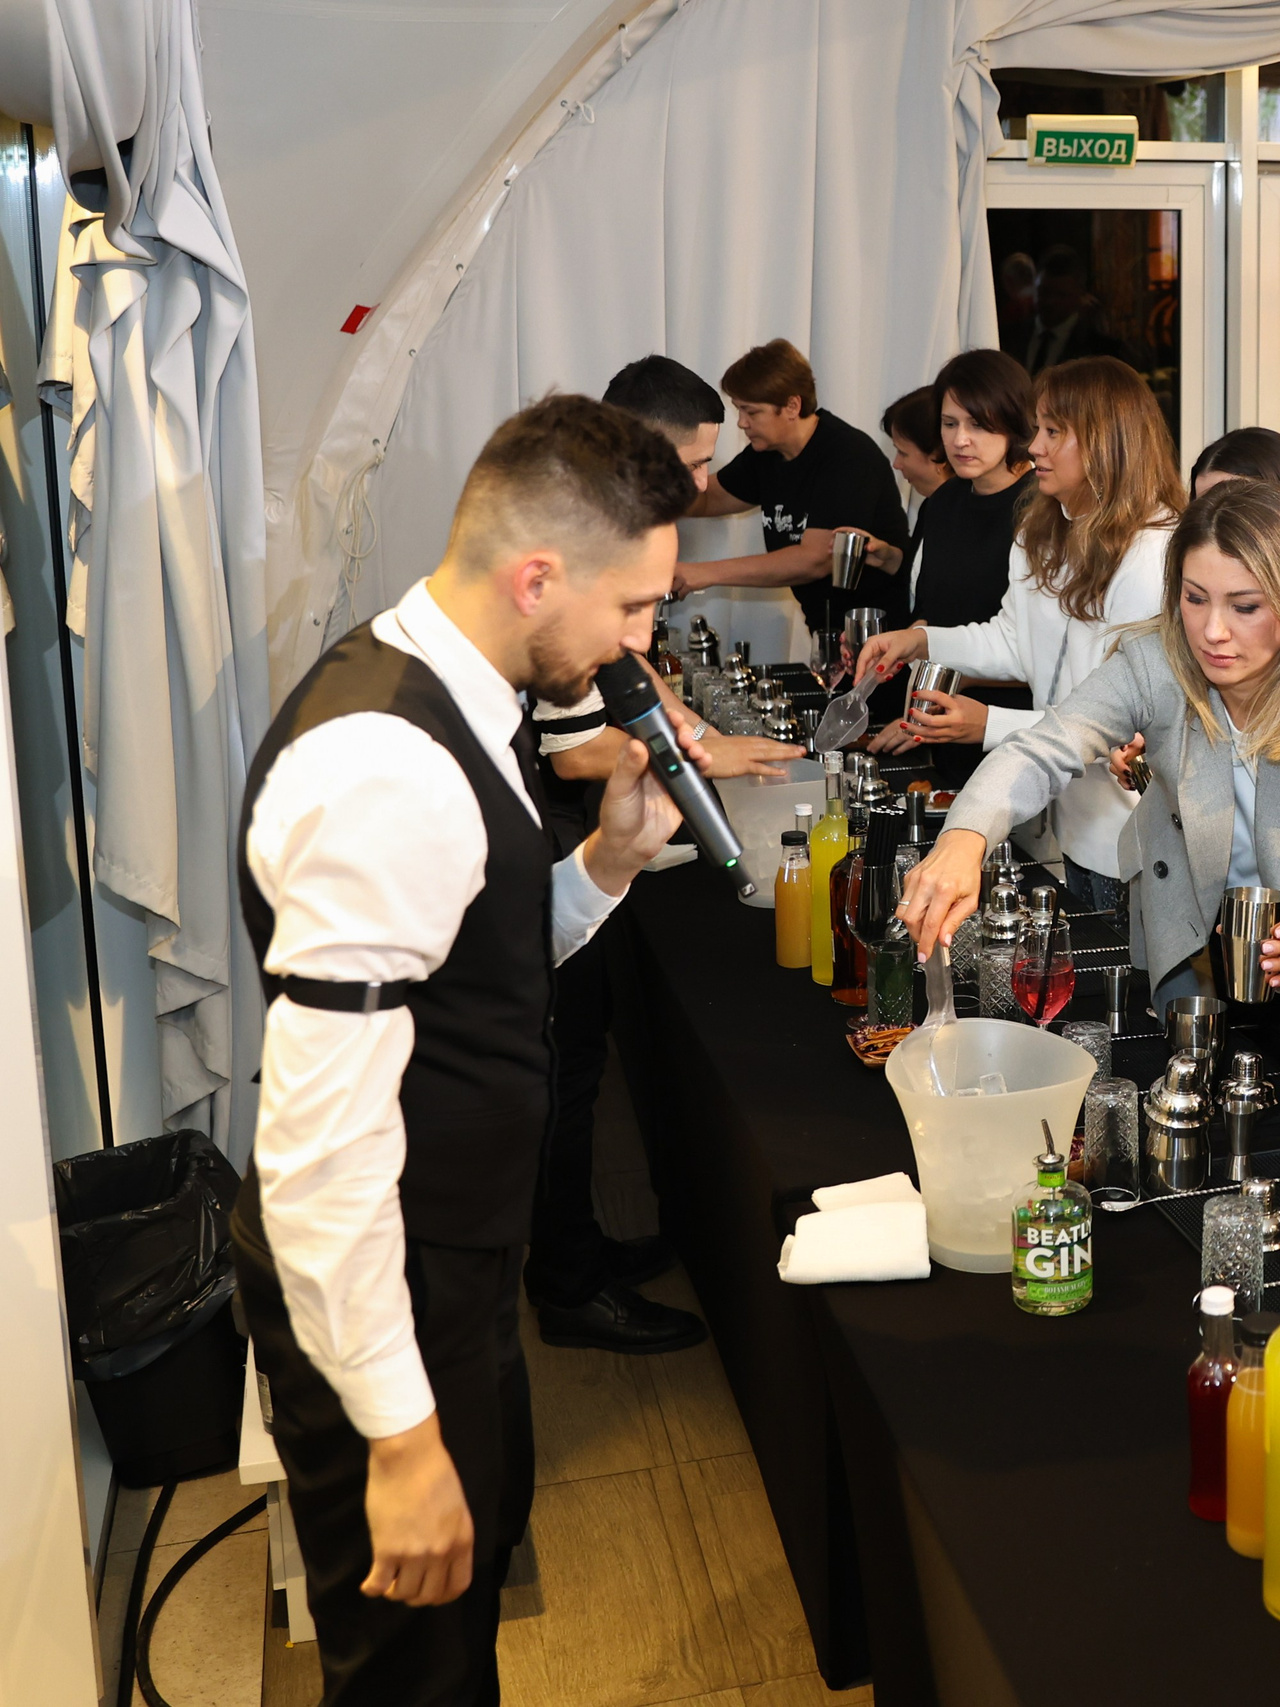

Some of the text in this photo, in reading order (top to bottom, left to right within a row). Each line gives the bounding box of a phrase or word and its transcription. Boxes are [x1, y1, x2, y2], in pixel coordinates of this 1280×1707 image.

[1043, 137, 1127, 162] ВЫХОД
[1027, 1218, 1092, 1246] BEATLY
[1025, 1236, 1092, 1278] GIN
